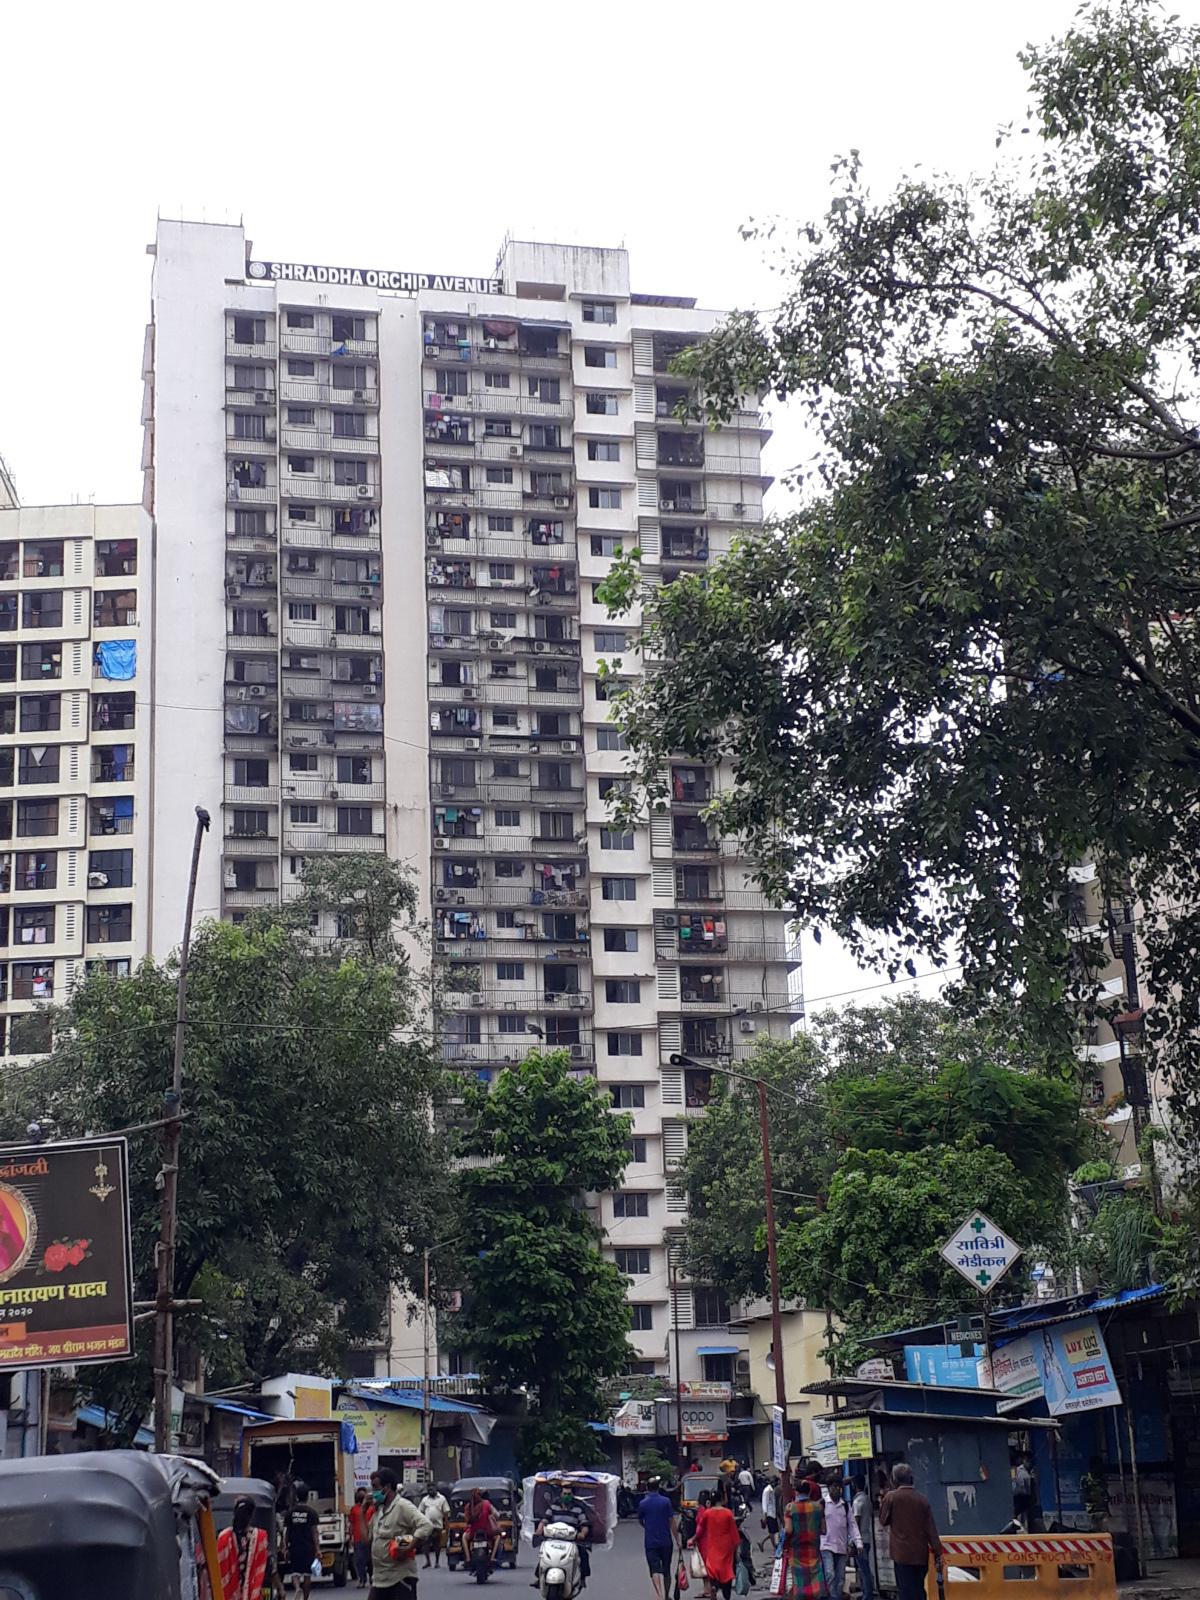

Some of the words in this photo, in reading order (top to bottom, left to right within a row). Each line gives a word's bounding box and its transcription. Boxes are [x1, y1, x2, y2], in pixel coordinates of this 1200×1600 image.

[270, 263, 363, 286] SHRADDHA
[366, 270, 429, 290] ORCHID
[432, 276, 498, 294] AVENUE
[955, 1236, 1004, 1250] सावित्री
[957, 1253, 1006, 1267] मेडीकल
[67, 1281, 107, 1298] यादव
[8, 1307, 33, 1317] २०२०
[951, 1331, 982, 1340] MEDICINES
[1065, 1340, 1082, 1353] LUX
[682, 1411, 713, 1425] oppo
[969, 1552, 998, 1563] FORCE
